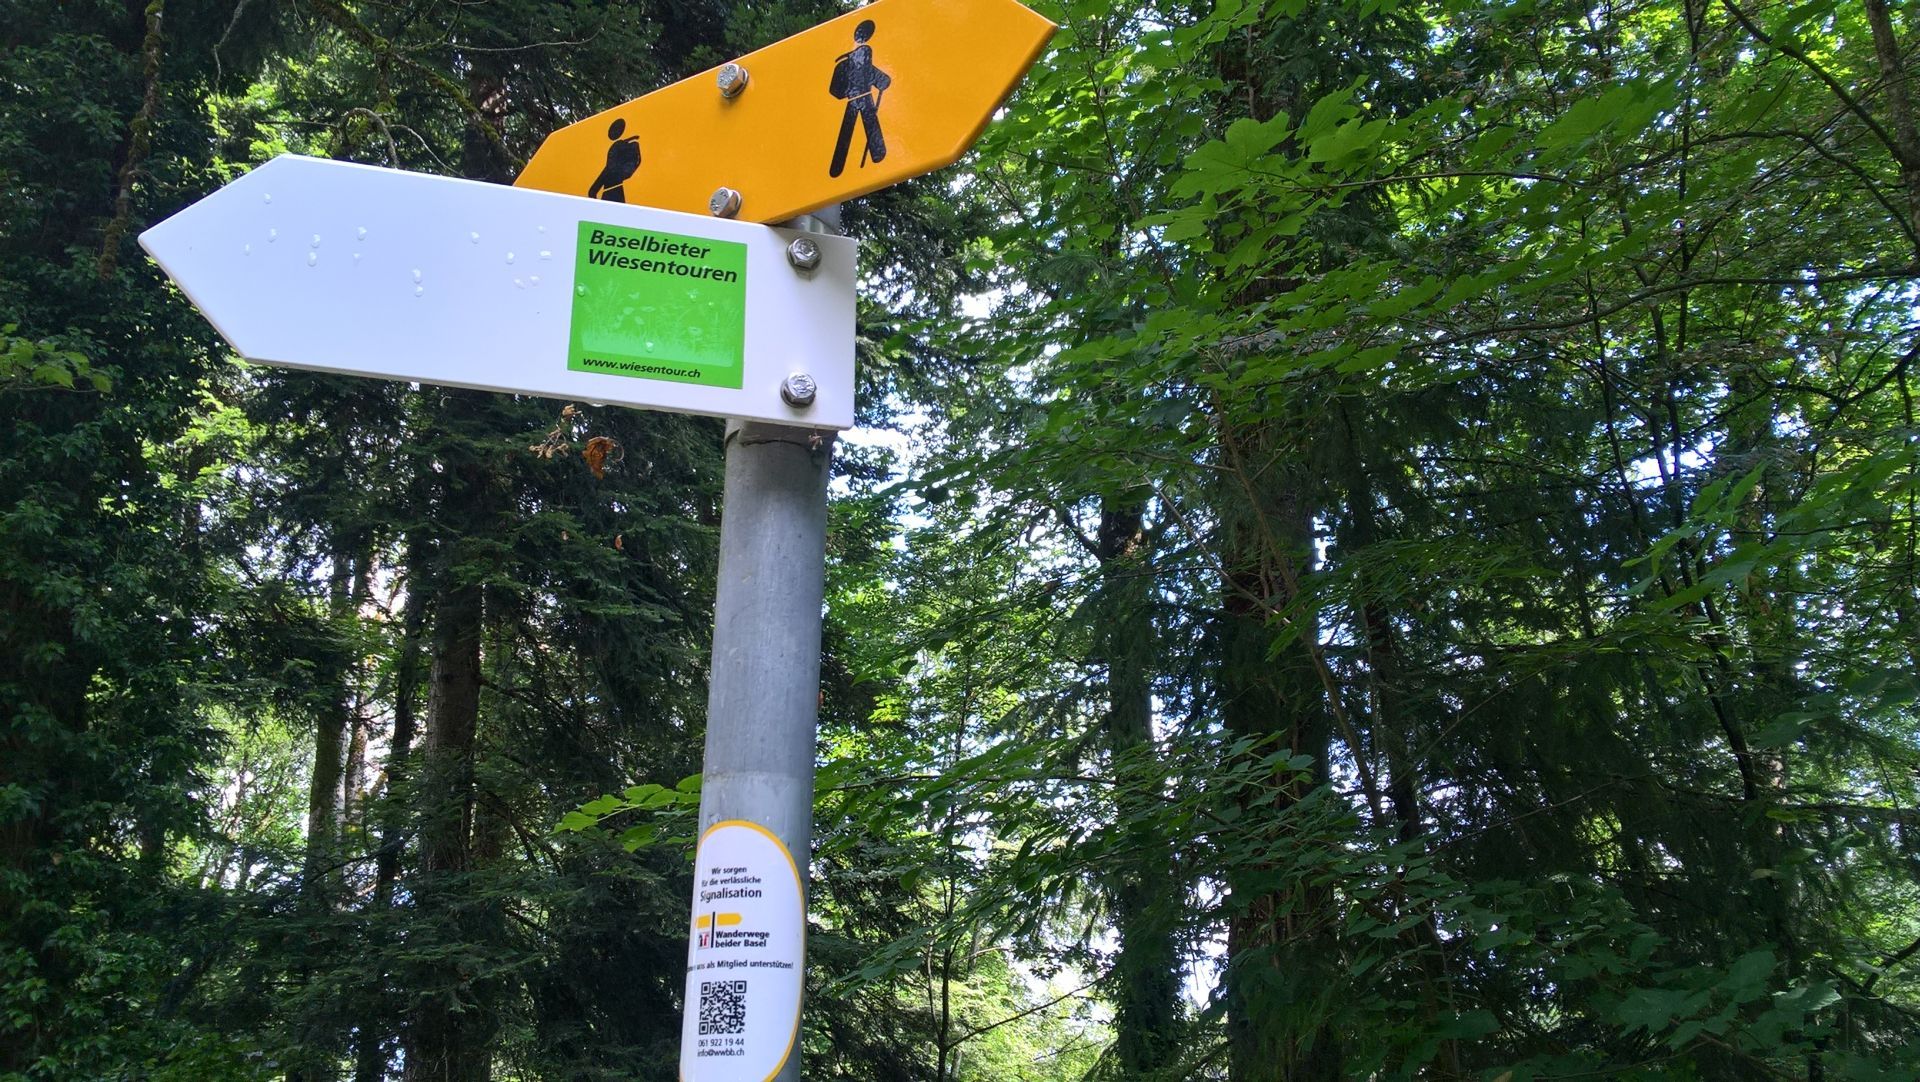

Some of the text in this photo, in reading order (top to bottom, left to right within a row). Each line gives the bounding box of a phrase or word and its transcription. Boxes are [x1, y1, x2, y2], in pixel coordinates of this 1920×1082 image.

[590, 229, 711, 259] Baselbieter
[588, 249, 738, 283] Wiesentouren
[583, 358, 701, 378] www.wiesentour.ch
[711, 867, 747, 875] Wir sorgen
[720, 876, 761, 884] verlässliche
[700, 887, 762, 903] Signalisation
[715, 930, 770, 938] Wanderwege
[715, 939, 767, 948] beider Basel
[706, 960, 716, 969] als
[717, 959, 748, 970] Mitglied
[710, 1038, 723, 1047] 922
[725, 1038, 734, 1046] 19
[734, 1038, 745, 1046] 44
